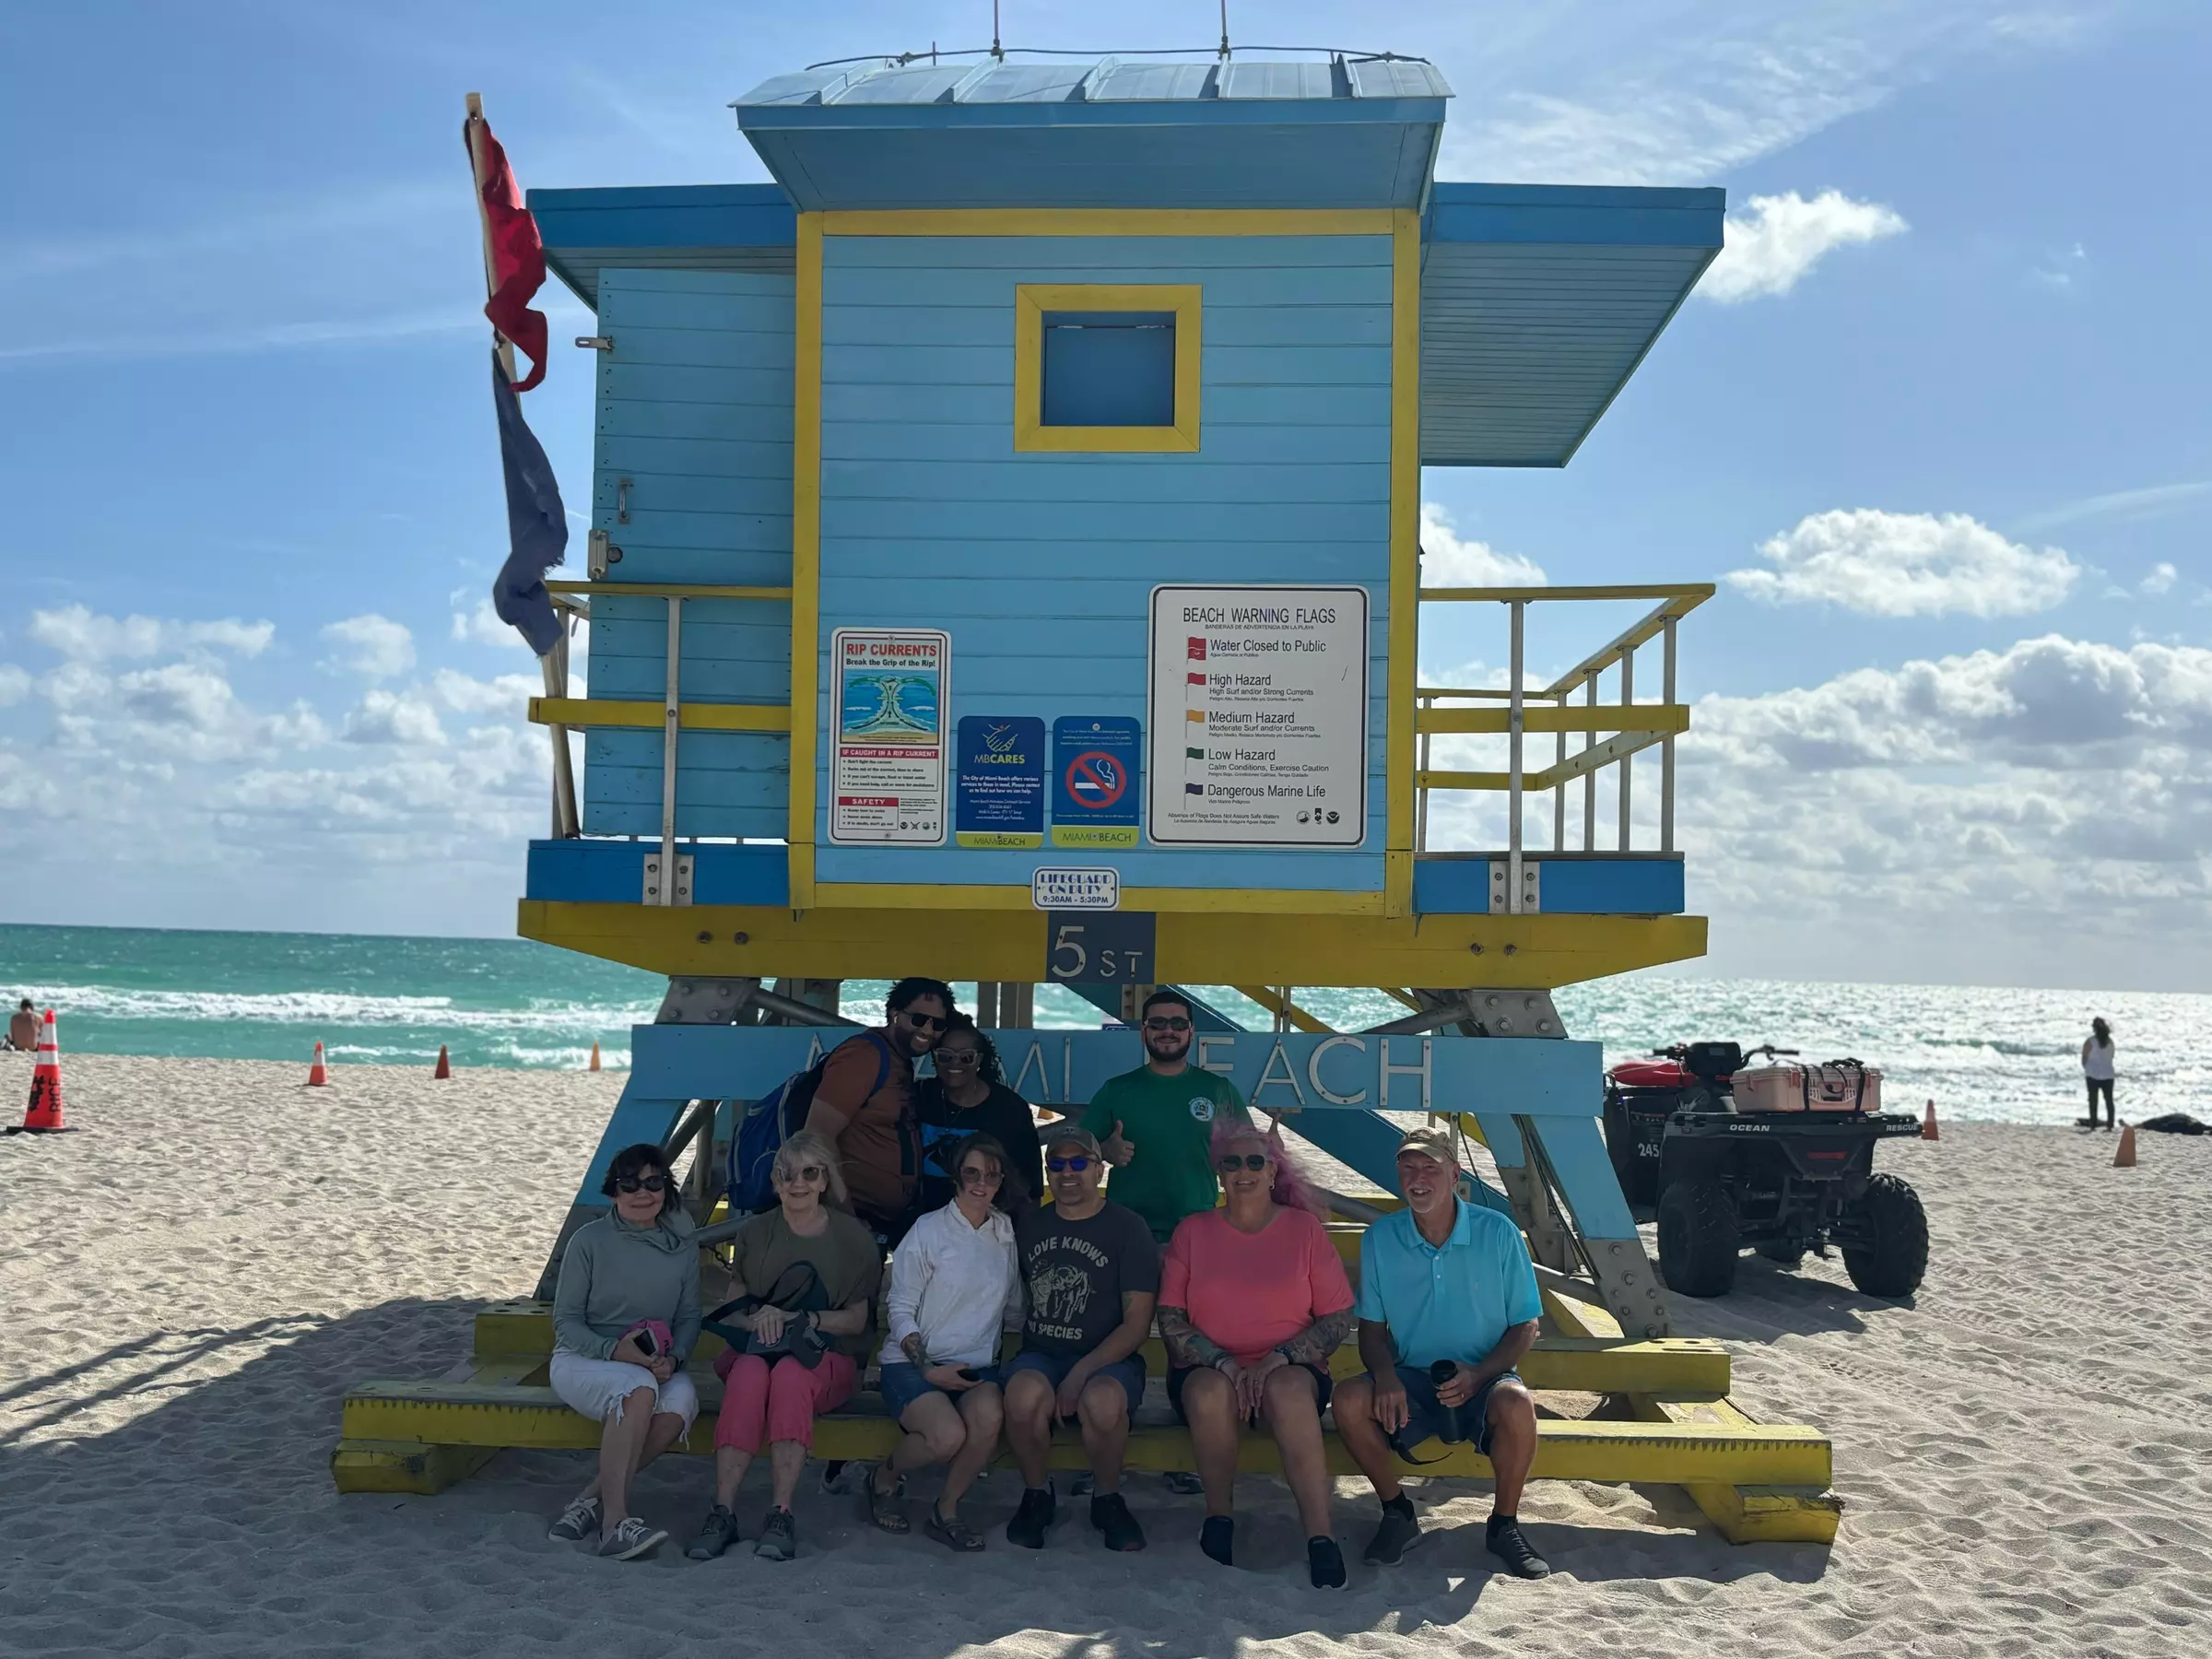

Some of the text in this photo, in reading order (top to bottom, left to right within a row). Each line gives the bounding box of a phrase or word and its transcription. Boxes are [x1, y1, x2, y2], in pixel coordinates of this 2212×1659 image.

[1183, 607, 1336, 623] BEACH WARNING FLAGS
[846, 643, 937, 656] RIP CURRENTS
[1210, 640, 1326, 653] Water Closed to Public
[882, 659, 898, 667] Grip
[1209, 674, 1271, 688] High Hazard
[1209, 688, 1224, 696] High
[1264, 688, 1285, 697] Strong
[1209, 712, 1295, 724] Medium Hazard
[974, 754, 1025, 764] MBCARES
[1208, 748, 1276, 761] Low Hazard
[1208, 763, 1329, 771] Calm Conditions, Exercise Caution
[1207, 784, 1326, 799] Dangerous Marine Life
[1041, 874, 1112, 884] LIFEGUARD
[1049, 885, 1102, 894] ON DUTY
[1042, 895, 1072, 903] 9:30AM
[1052, 925, 1143, 978] 5 ST
[1144, 1036, 1431, 1108] EACH
[1729, 1124, 1771, 1132] OCEAN
[1886, 1124, 1919, 1132] RESCUE
[1637, 1143, 1660, 1158] 245
[1028, 1236, 1109, 1268] LOVE KNOWS
[1038, 1323, 1083, 1340] SPECIES
